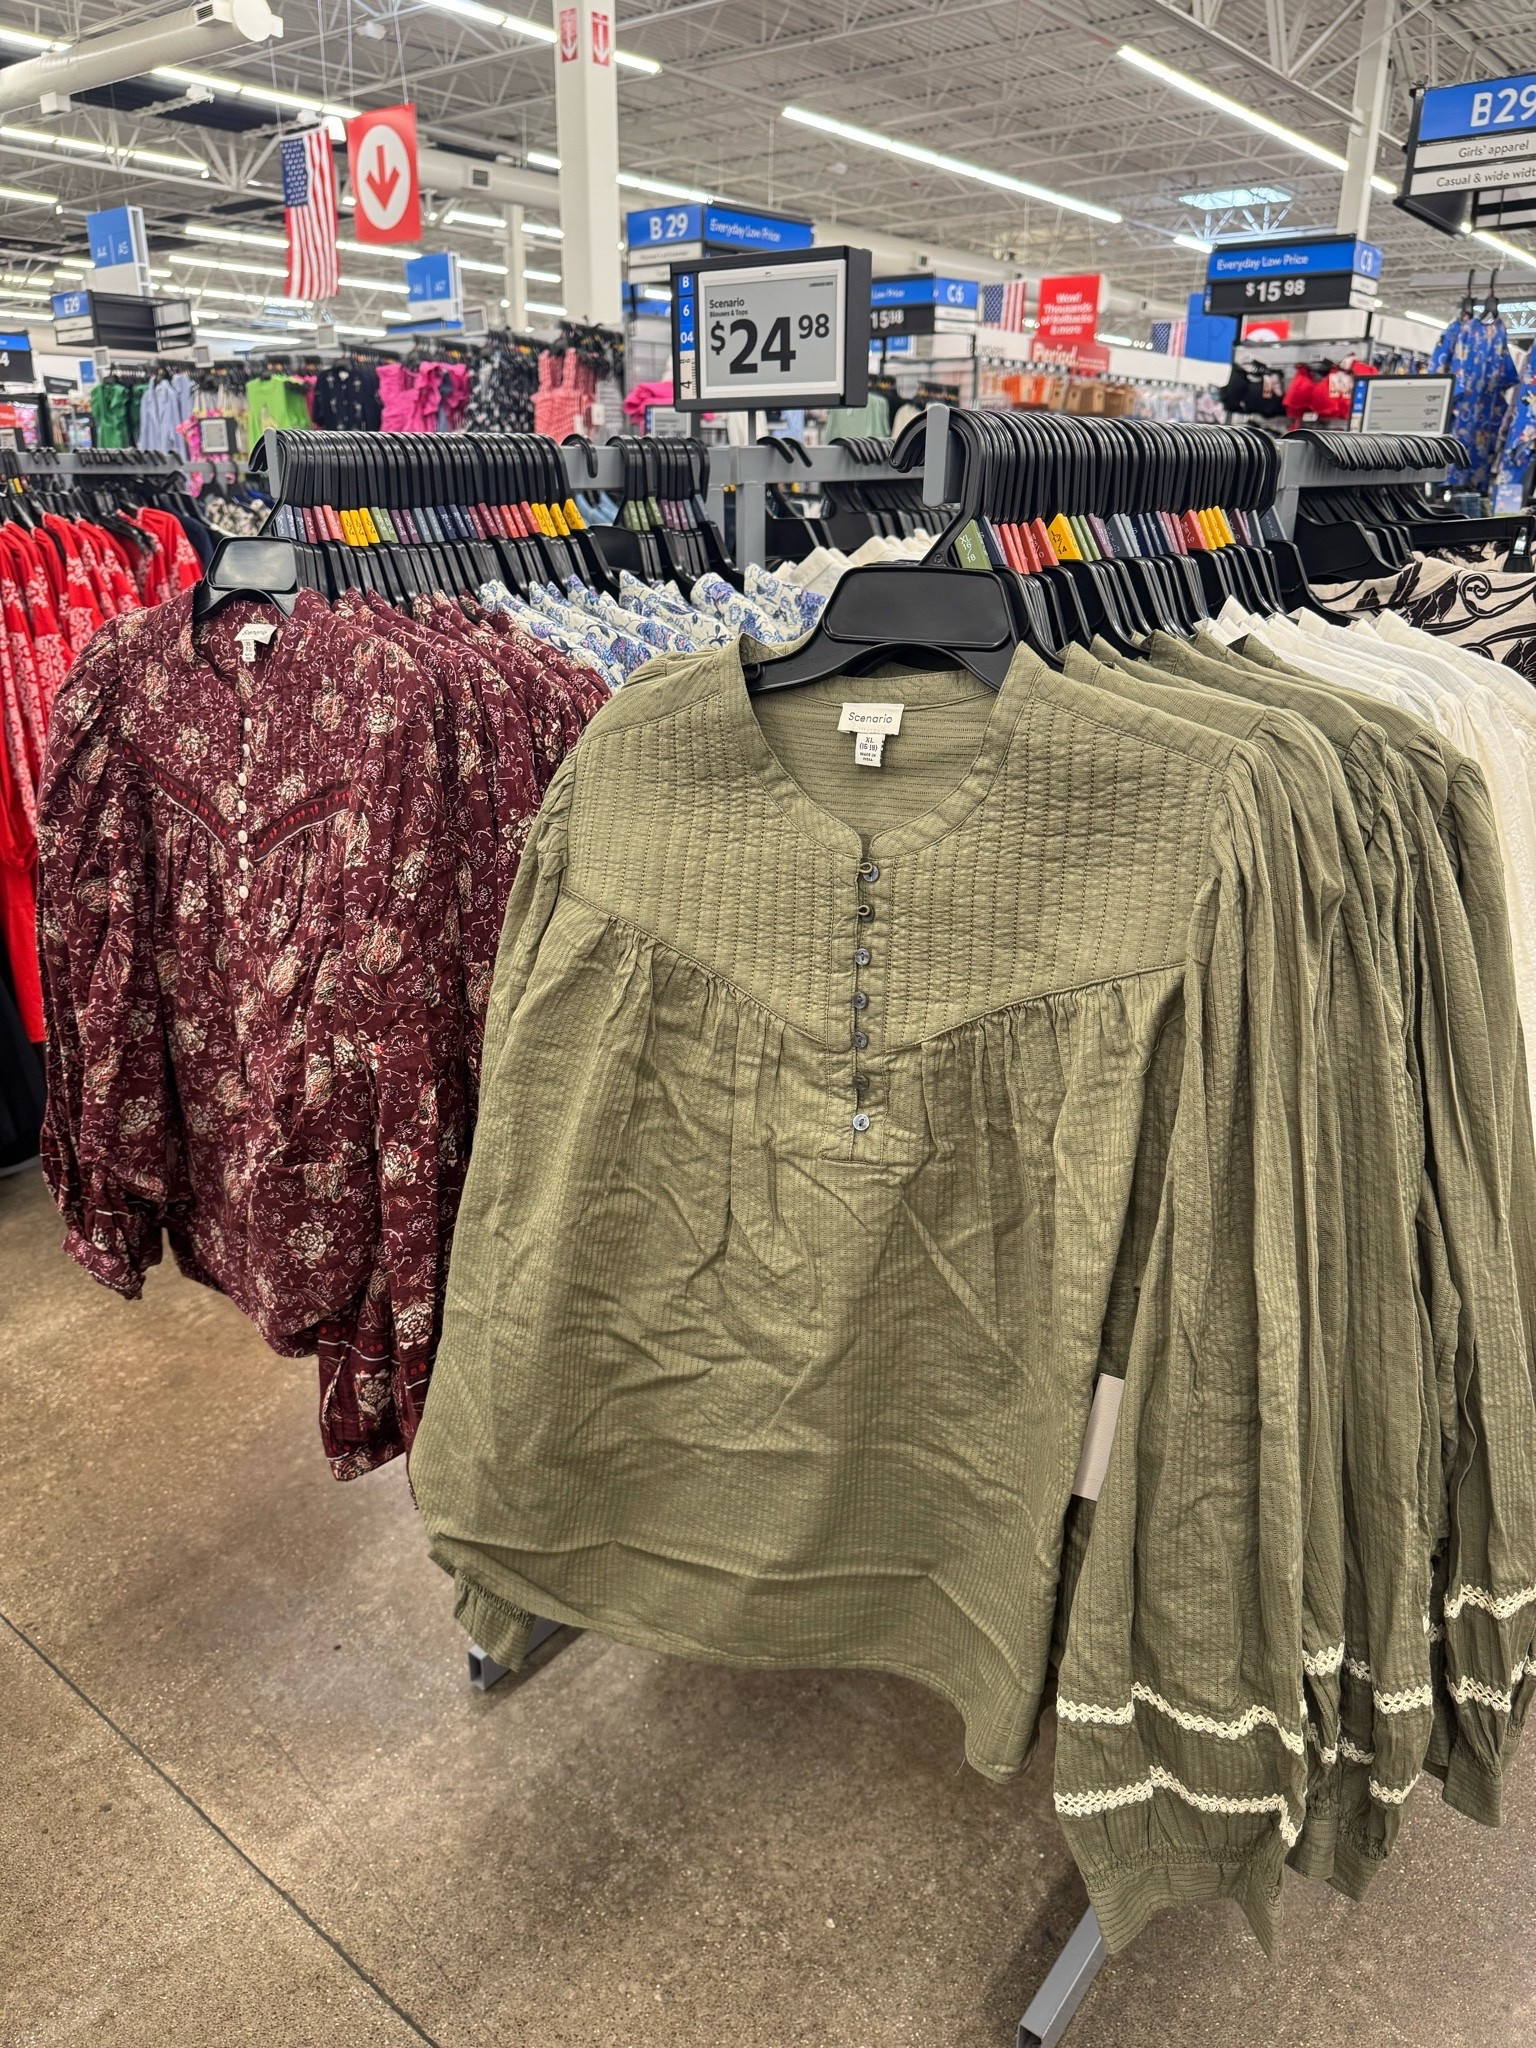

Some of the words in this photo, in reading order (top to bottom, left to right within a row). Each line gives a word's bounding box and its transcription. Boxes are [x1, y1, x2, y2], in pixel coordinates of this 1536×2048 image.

[1470, 84, 1536, 127] B29
[1458, 145, 1487, 158] Girls'
[1488, 140, 1530, 156] apparel
[1436, 174, 1471, 187] Casual
[1473, 172, 1481, 183] &
[1484, 170, 1510, 182] wide
[650, 216, 663, 241] B
[665, 212, 689, 239] 29
[709, 217, 745, 240] Everyday
[745, 223, 760, 239] Low
[1216, 255, 1261, 272] Everyday
[1261, 255, 1282, 268] Low
[1282, 253, 1309, 266] Price
[682, 275, 689, 288] B
[683, 304, 690, 316] 6
[709, 297, 745, 309] Scenario
[709, 310, 729, 318] Blouses
[735, 309, 748, 318] Tops
[680, 331, 694, 343] 04
[848, 711, 893, 724] Scenario
